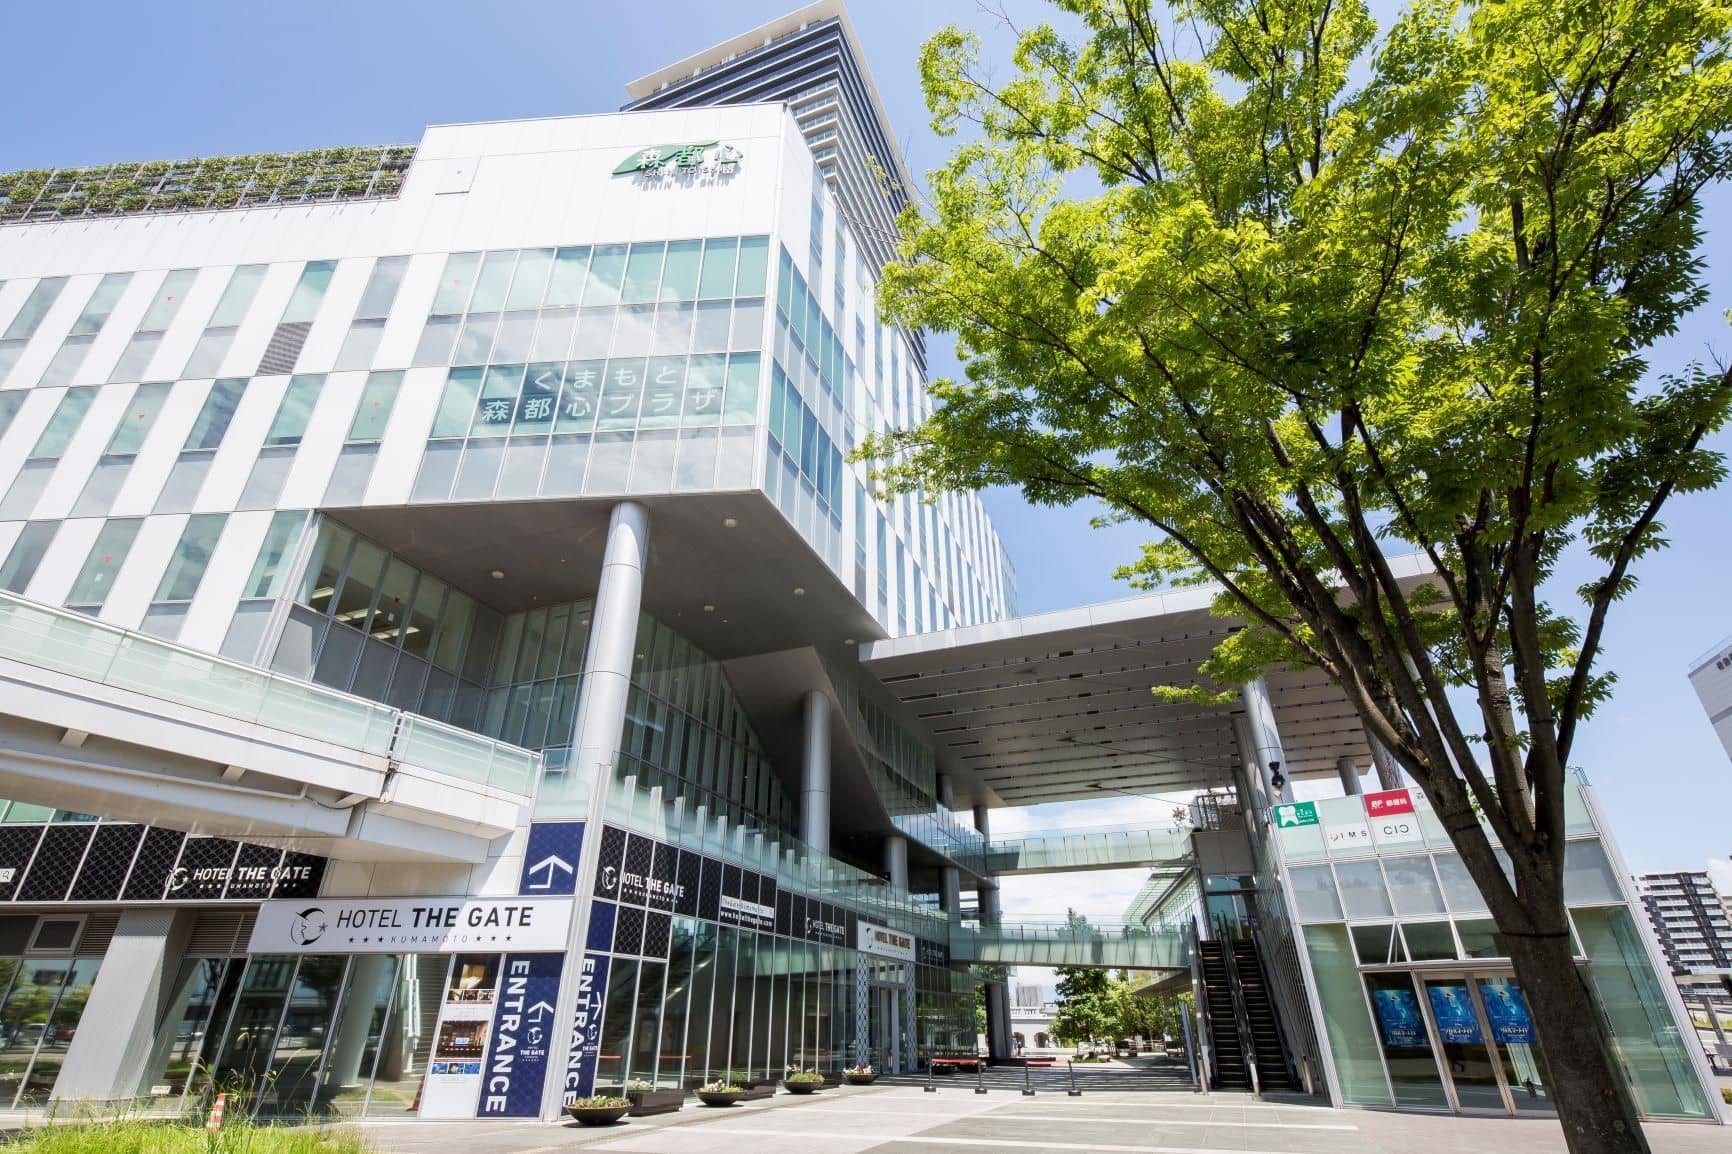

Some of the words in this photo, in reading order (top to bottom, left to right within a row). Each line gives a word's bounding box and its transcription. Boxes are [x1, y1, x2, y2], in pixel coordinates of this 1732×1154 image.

[533, 366, 678, 390] くまもと
[481, 388, 719, 422] 森都心プラザ
[193, 868, 232, 880] HOTEL
[237, 867, 268, 880] THE
[270, 866, 312, 880] GATE
[645, 876, 663, 893] THE
[336, 909, 402, 929] HOTEL
[411, 907, 460, 929] THE
[467, 906, 534, 928] GATE
[390, 934, 469, 945] KUMAMOTO
[485, 960, 531, 1112] ENTRANCE
[565, 958, 596, 1106] ENTRANCE
